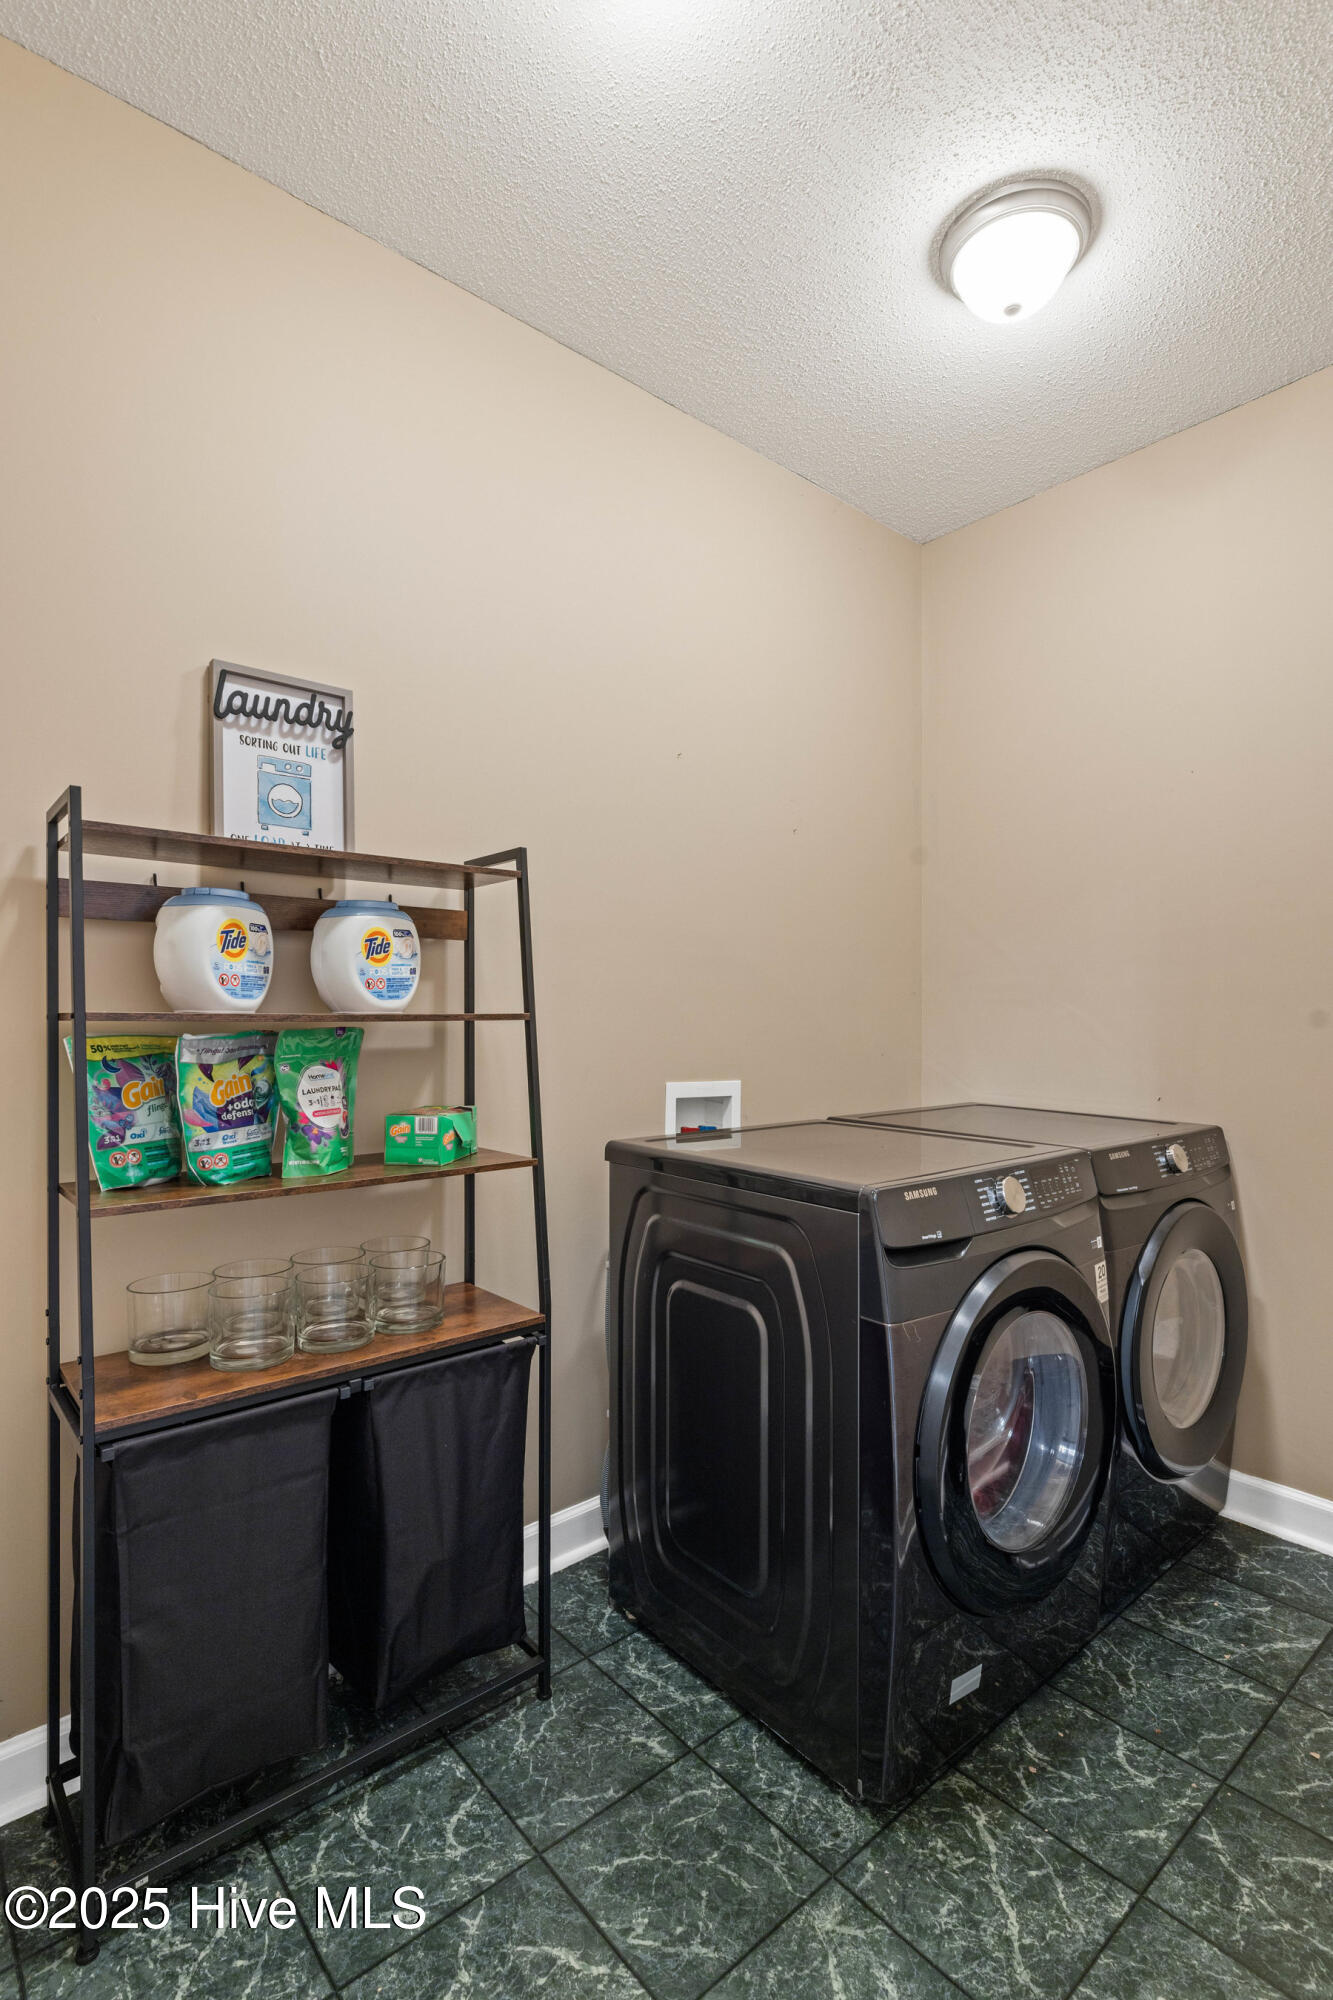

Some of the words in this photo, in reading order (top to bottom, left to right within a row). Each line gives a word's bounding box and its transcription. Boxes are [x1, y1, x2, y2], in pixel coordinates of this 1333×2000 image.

[214, 669, 354, 749] laundry
[239, 734, 278, 751] SORTING
[283, 742, 301, 756] OUT
[305, 745, 326, 760] LIFE
[220, 929, 247, 953] Tide
[364, 937, 391, 960] Tide
[122, 1076, 166, 1110] Gain
[211, 1074, 253, 1107] Gain
[301, 1086, 332, 1096] LAUNDRY
[221, 1108, 254, 1121] defens
[390, 1123, 411, 1137] Gain
[903, 1187, 938, 1201] SAMSUNG
[1097, 1264, 1106, 1280] 20
